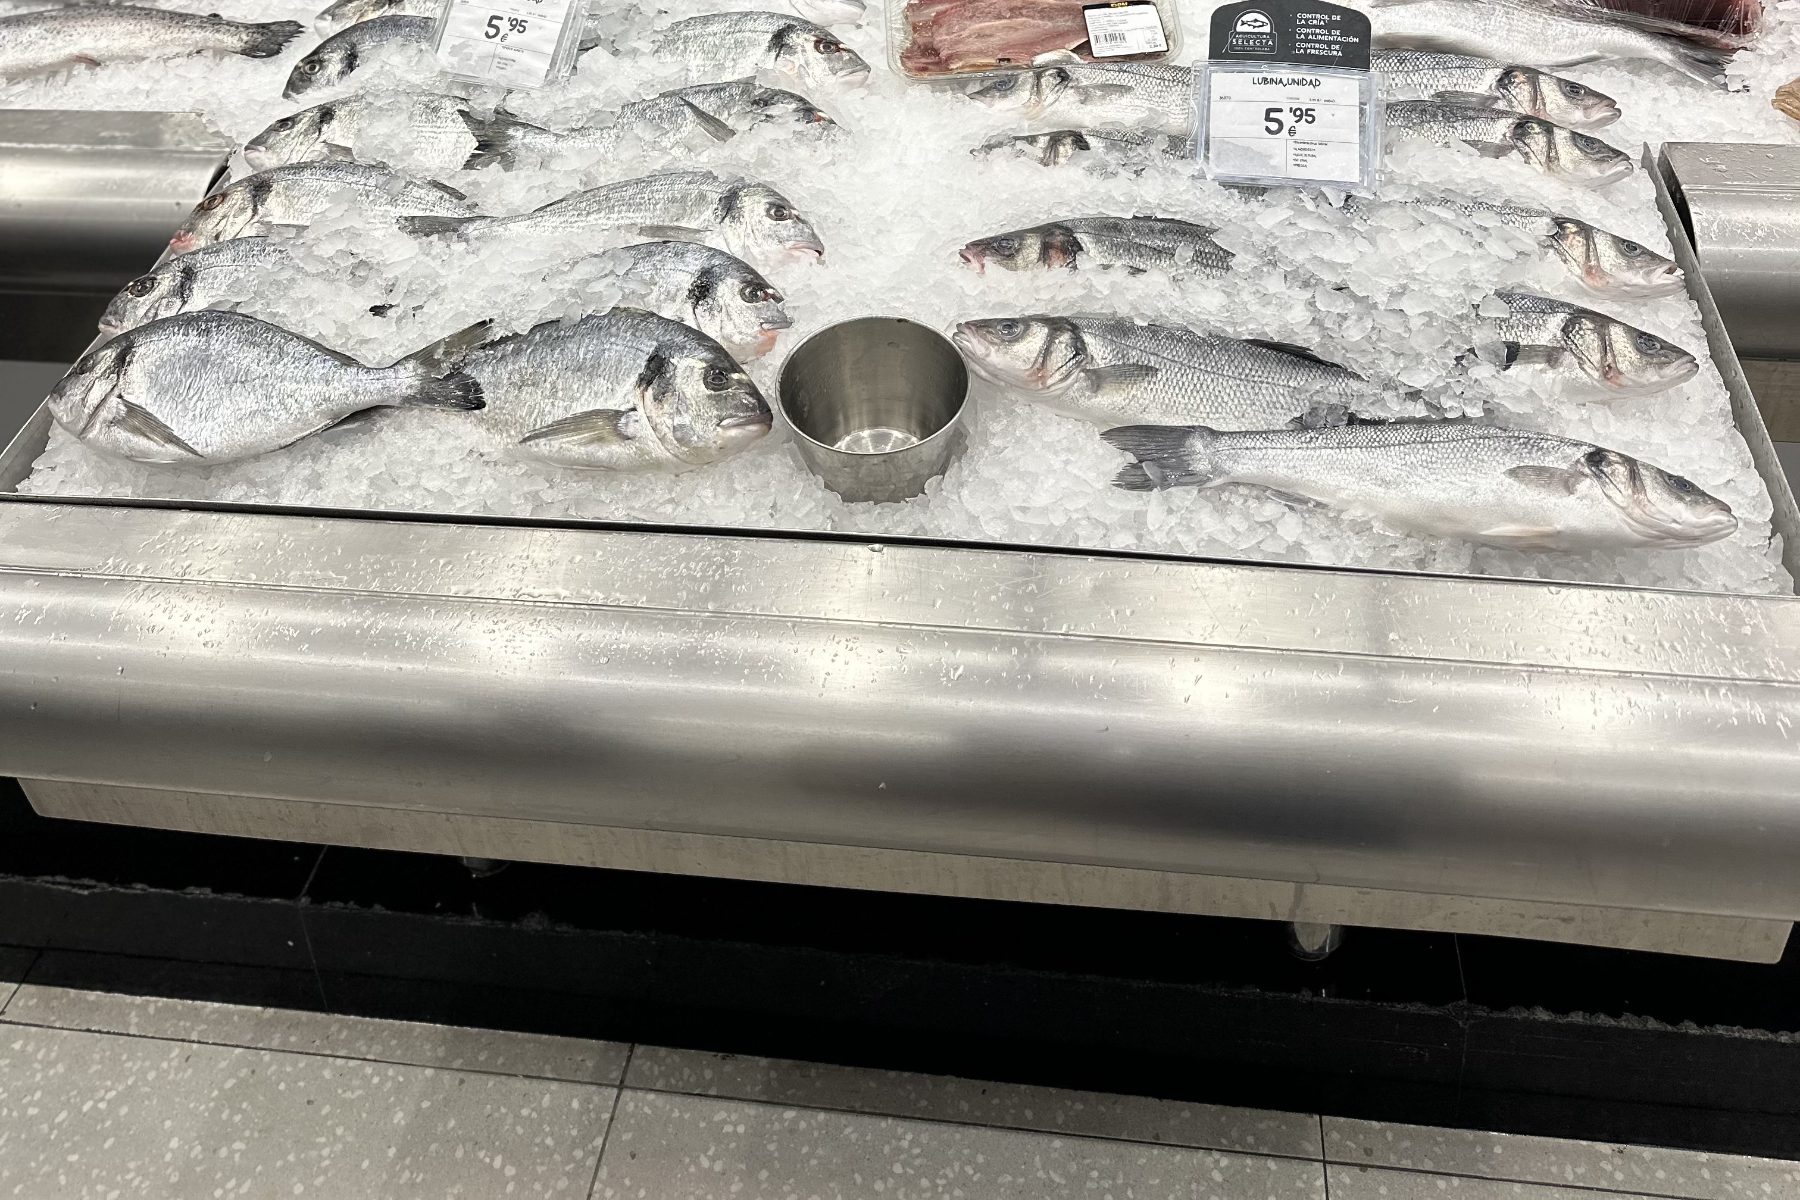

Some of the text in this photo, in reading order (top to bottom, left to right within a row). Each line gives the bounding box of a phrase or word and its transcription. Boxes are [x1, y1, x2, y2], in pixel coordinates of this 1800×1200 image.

[500, 33, 509, 43] €
[1306, 49, 1343, 57] FRESCURA
[1288, 125, 1297, 137] €
